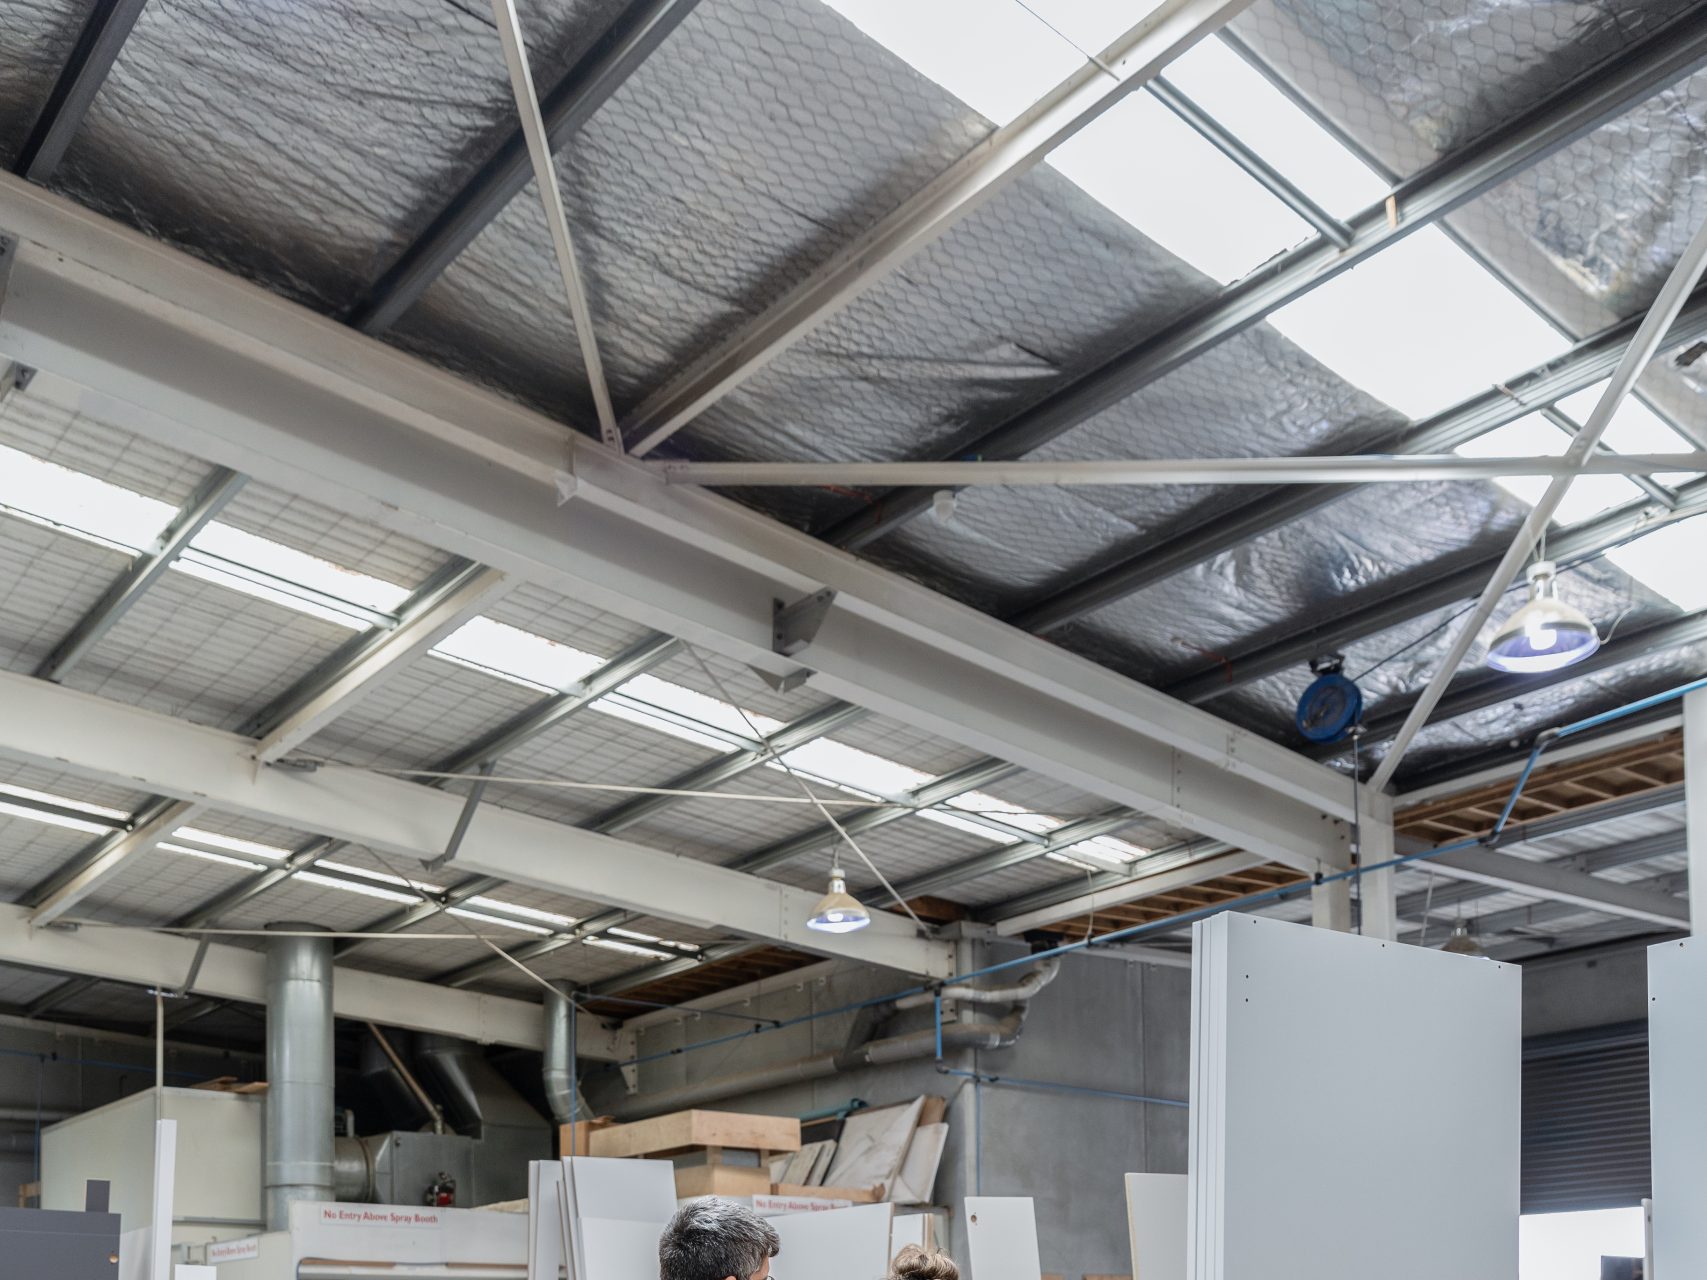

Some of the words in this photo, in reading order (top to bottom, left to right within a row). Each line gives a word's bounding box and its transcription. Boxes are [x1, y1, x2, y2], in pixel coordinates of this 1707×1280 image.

[323, 1209, 337, 1220] No
[339, 1210, 361, 1222] Entry
[363, 1211, 388, 1222] Above
[390, 1212, 412, 1225] Spray
[414, 1213, 438, 1224] Booth
